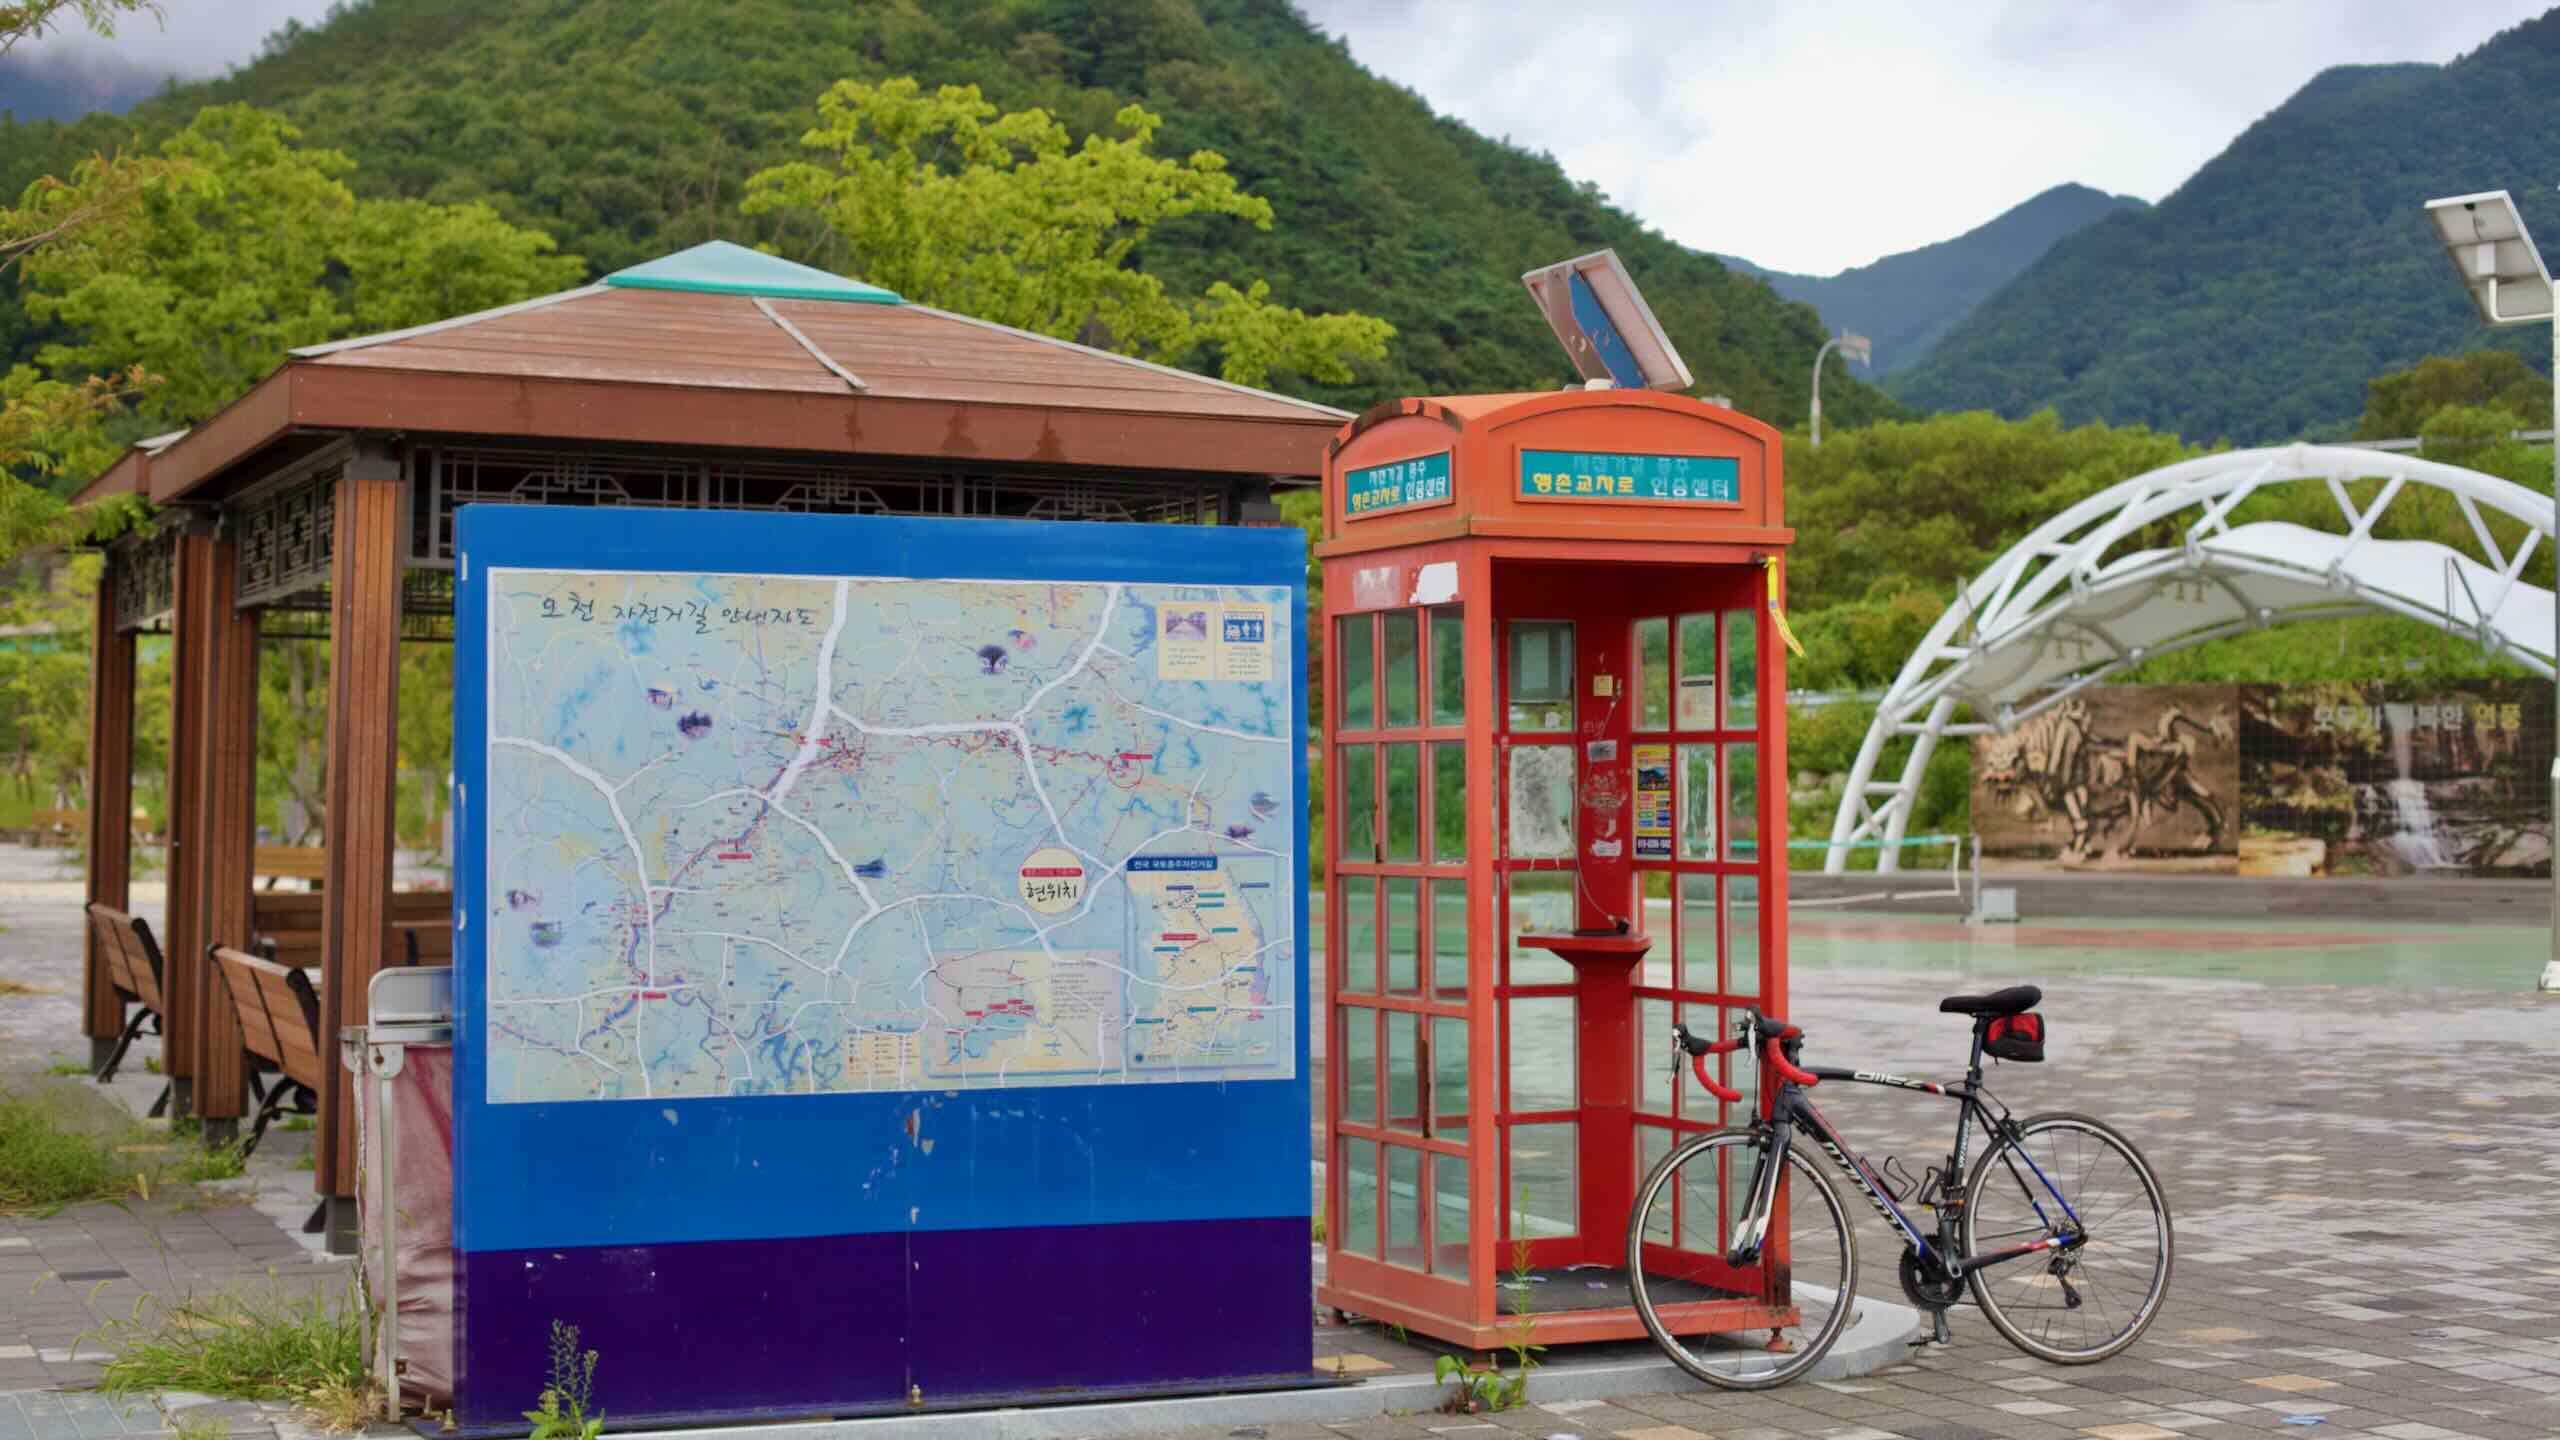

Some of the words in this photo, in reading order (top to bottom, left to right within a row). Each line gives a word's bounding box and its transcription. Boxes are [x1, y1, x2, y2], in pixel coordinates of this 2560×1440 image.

[1651, 477, 1729, 502] 인증센터
[541, 592, 595, 622] 오천
[612, 601, 713, 634] 자전거길
[721, 607, 816, 625] 안내지도
[1026, 880, 1077, 902] 현위치
